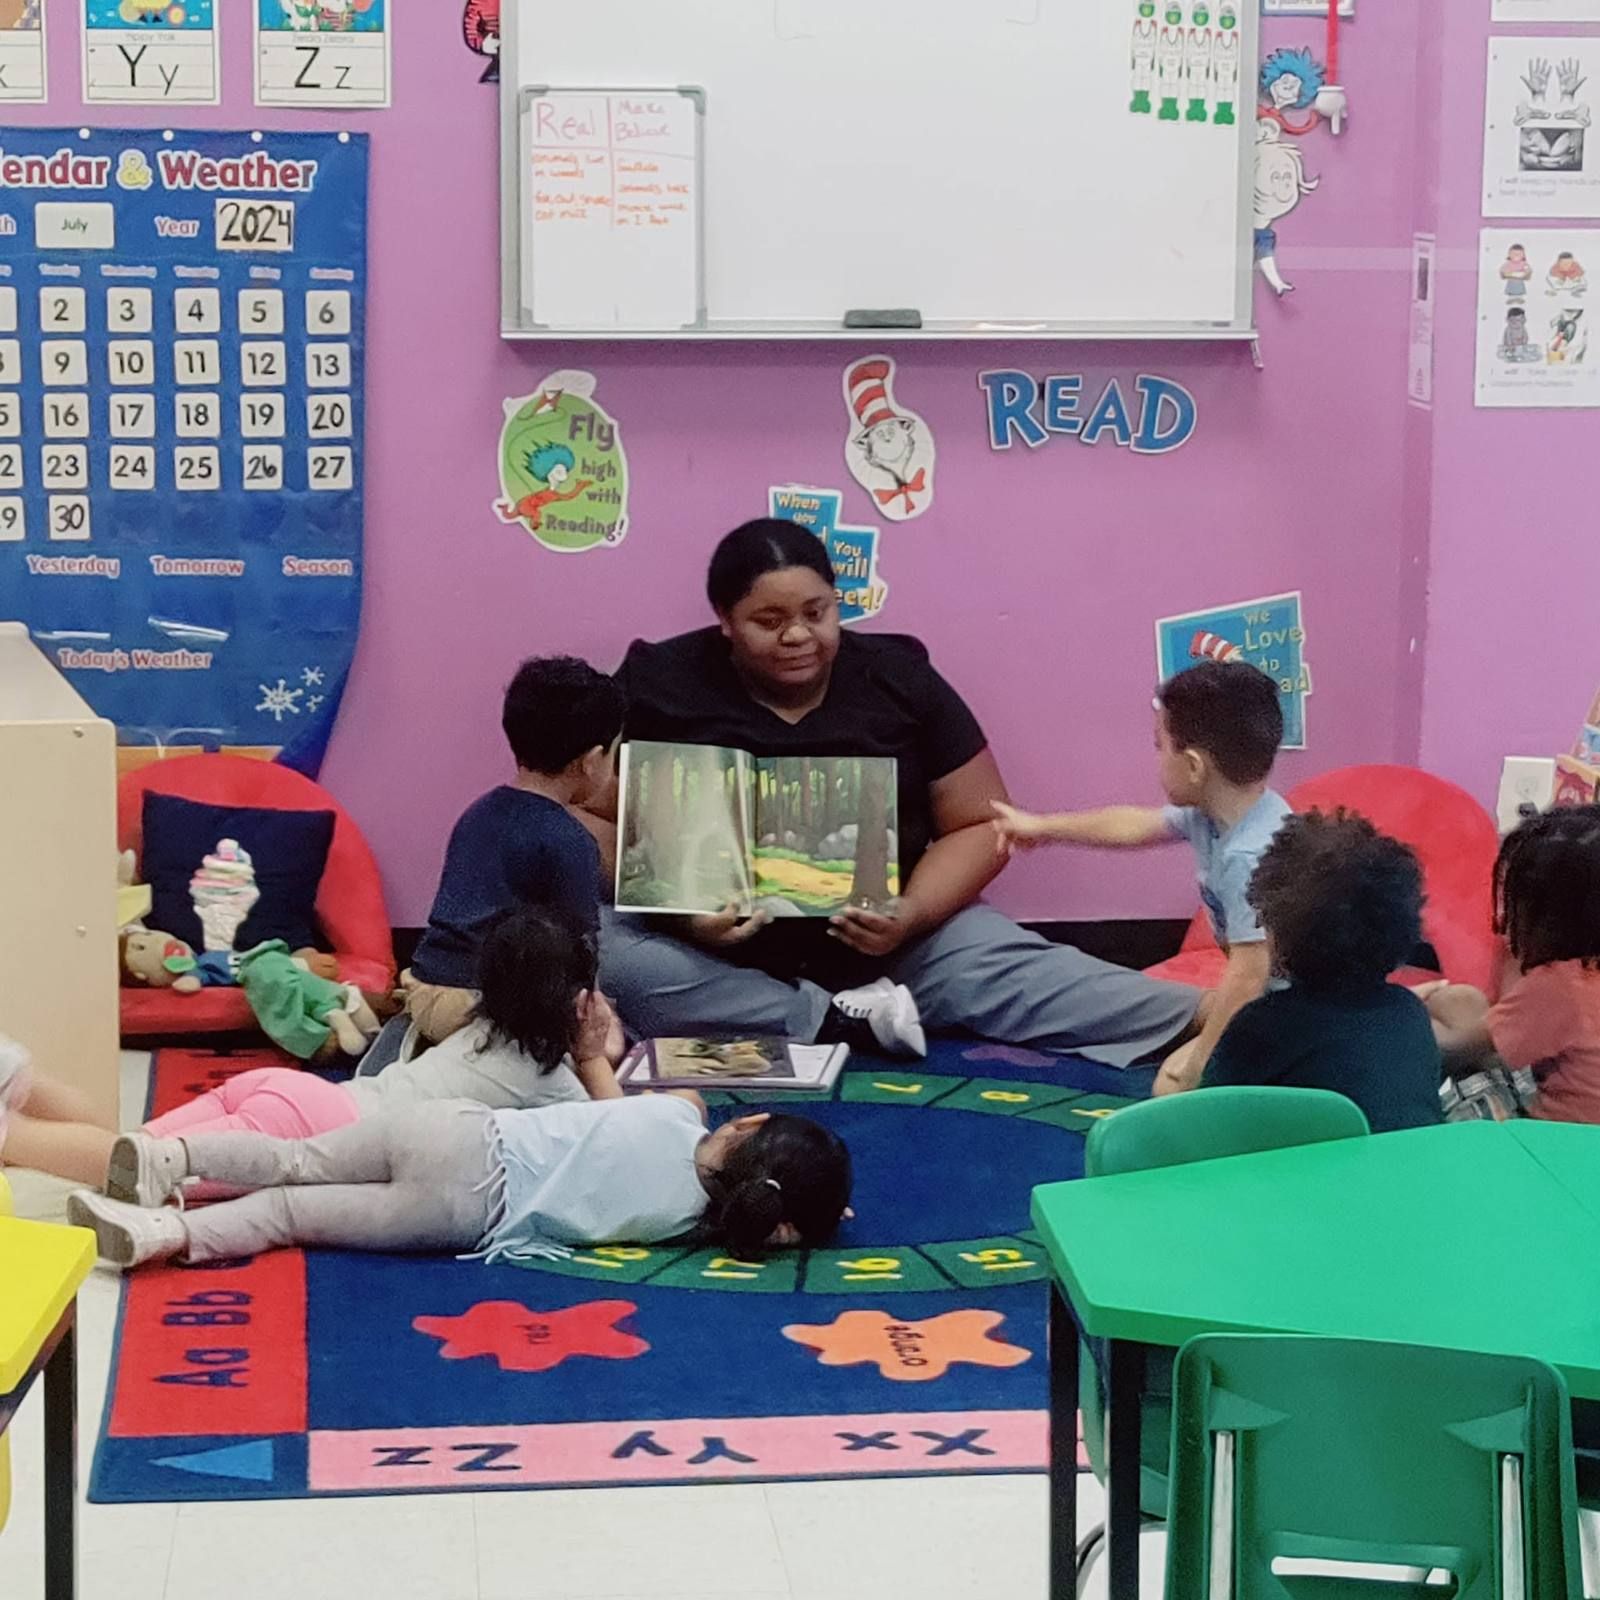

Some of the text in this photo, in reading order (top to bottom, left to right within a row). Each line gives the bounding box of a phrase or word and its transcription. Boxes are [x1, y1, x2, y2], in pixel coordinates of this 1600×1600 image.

[536, 102, 596, 140] Real
[2, 152, 314, 188] endar & Weather
[61, 217, 89, 234] July
[156, 217, 198, 235] Year
[219, 202, 291, 244] 2024
[54, 298, 335, 324] 2 3 4 5 6
[54, 351, 341, 377] 9 10 11 12 13
[0, 402, 345, 431] 5 16 17 18 19 20
[978, 368, 1198, 454] READ
[568, 412, 615, 451] Fly
[0, 454, 346, 480] 2 23 24 25 26 27
[581, 458, 616, 482] high
[586, 488, 622, 505] with
[776, 493, 820, 511] When
[0, 503, 85, 533] 9 30
[546, 514, 625, 542] Reading!
[833, 540, 862, 557] You
[28, 556, 119, 577] Yesterday
[152, 557, 243, 574] Tomorrow
[284, 557, 352, 575] Season
[1245, 626, 1305, 651] Love
[60, 651, 212, 671] Today's Weather
[1280, 664, 1311, 693] ad
[572, 1246, 651, 1268] 18
[835, 1257, 903, 1280] 16
[959, 1247, 1036, 1271] 15
[162, 1289, 252, 1327] Bb
[517, 1323, 551, 1345] red
[882, 1324, 929, 1368] orange
[152, 1348, 250, 1388] Aa
